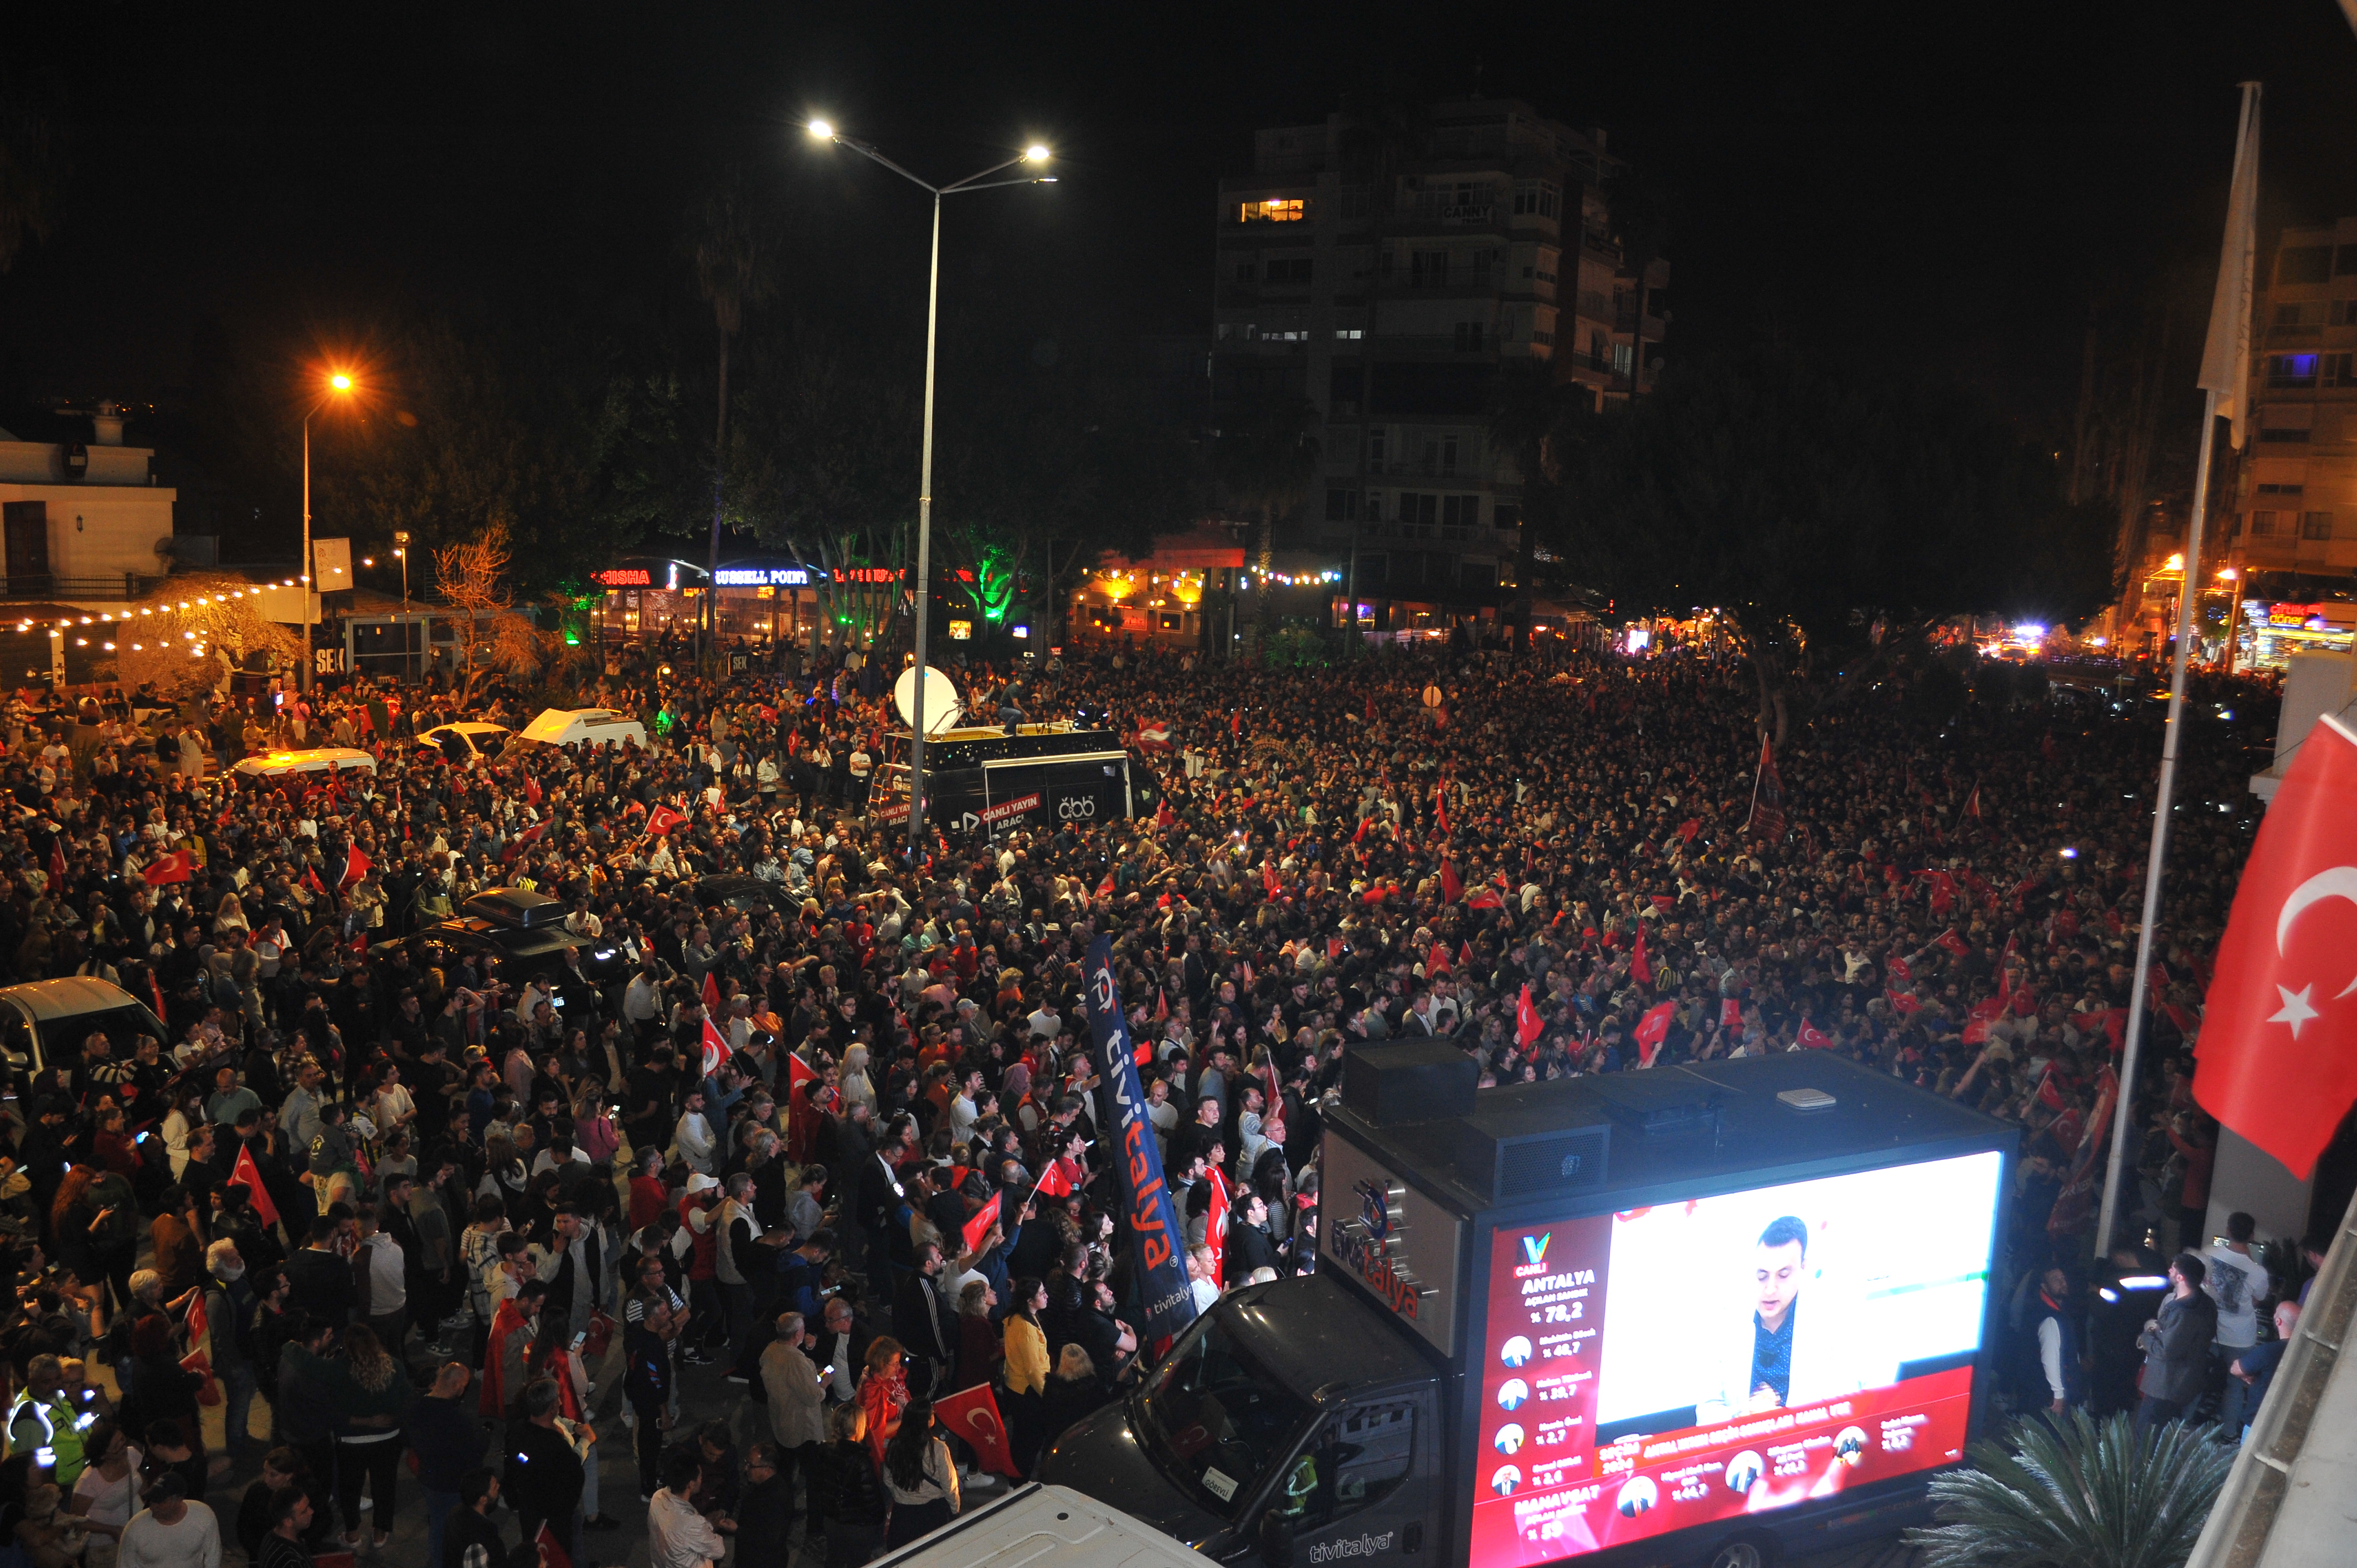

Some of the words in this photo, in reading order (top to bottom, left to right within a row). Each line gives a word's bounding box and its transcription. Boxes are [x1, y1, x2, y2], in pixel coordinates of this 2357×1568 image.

[590, 570, 650, 585] HISHA
[881, 807, 898, 817] CANLI
[983, 806, 1010, 821] CANLI
[1011, 797, 1037, 812] YAYIN
[1107, 1029, 1170, 1270] tivitalya
[1516, 1262, 1546, 1277] CANLI
[1521, 1270, 1595, 1294] ANTALYA
[1205, 1479, 1229, 1497] GÖREVLİ
[1514, 1484, 1599, 1515] MANAVGAT
[1310, 1533, 1390, 1564] tivitalya
